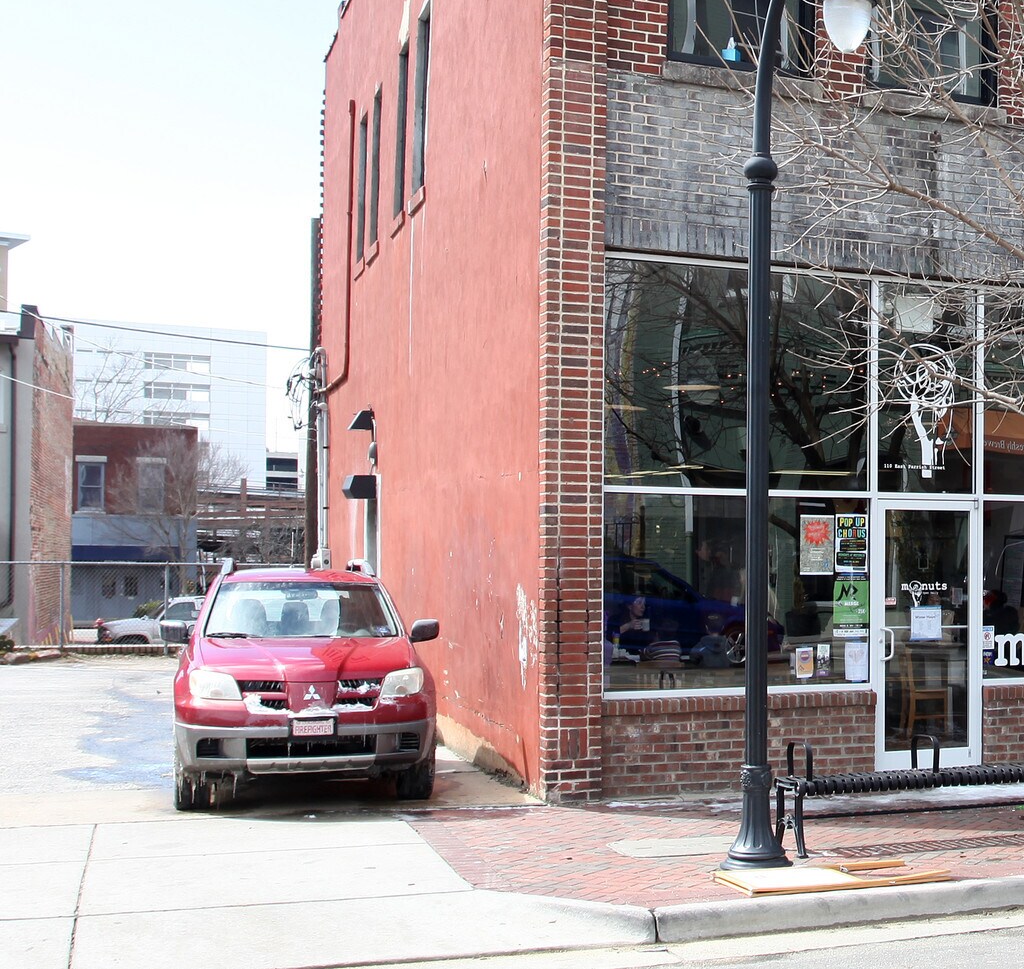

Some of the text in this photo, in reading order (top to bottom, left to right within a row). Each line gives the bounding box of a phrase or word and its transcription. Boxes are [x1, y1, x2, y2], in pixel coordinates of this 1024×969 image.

[839, 517, 865, 527] POP UP
[837, 529, 866, 538] CHORUS
[294, 724, 332, 734] FIREFIGHTER
